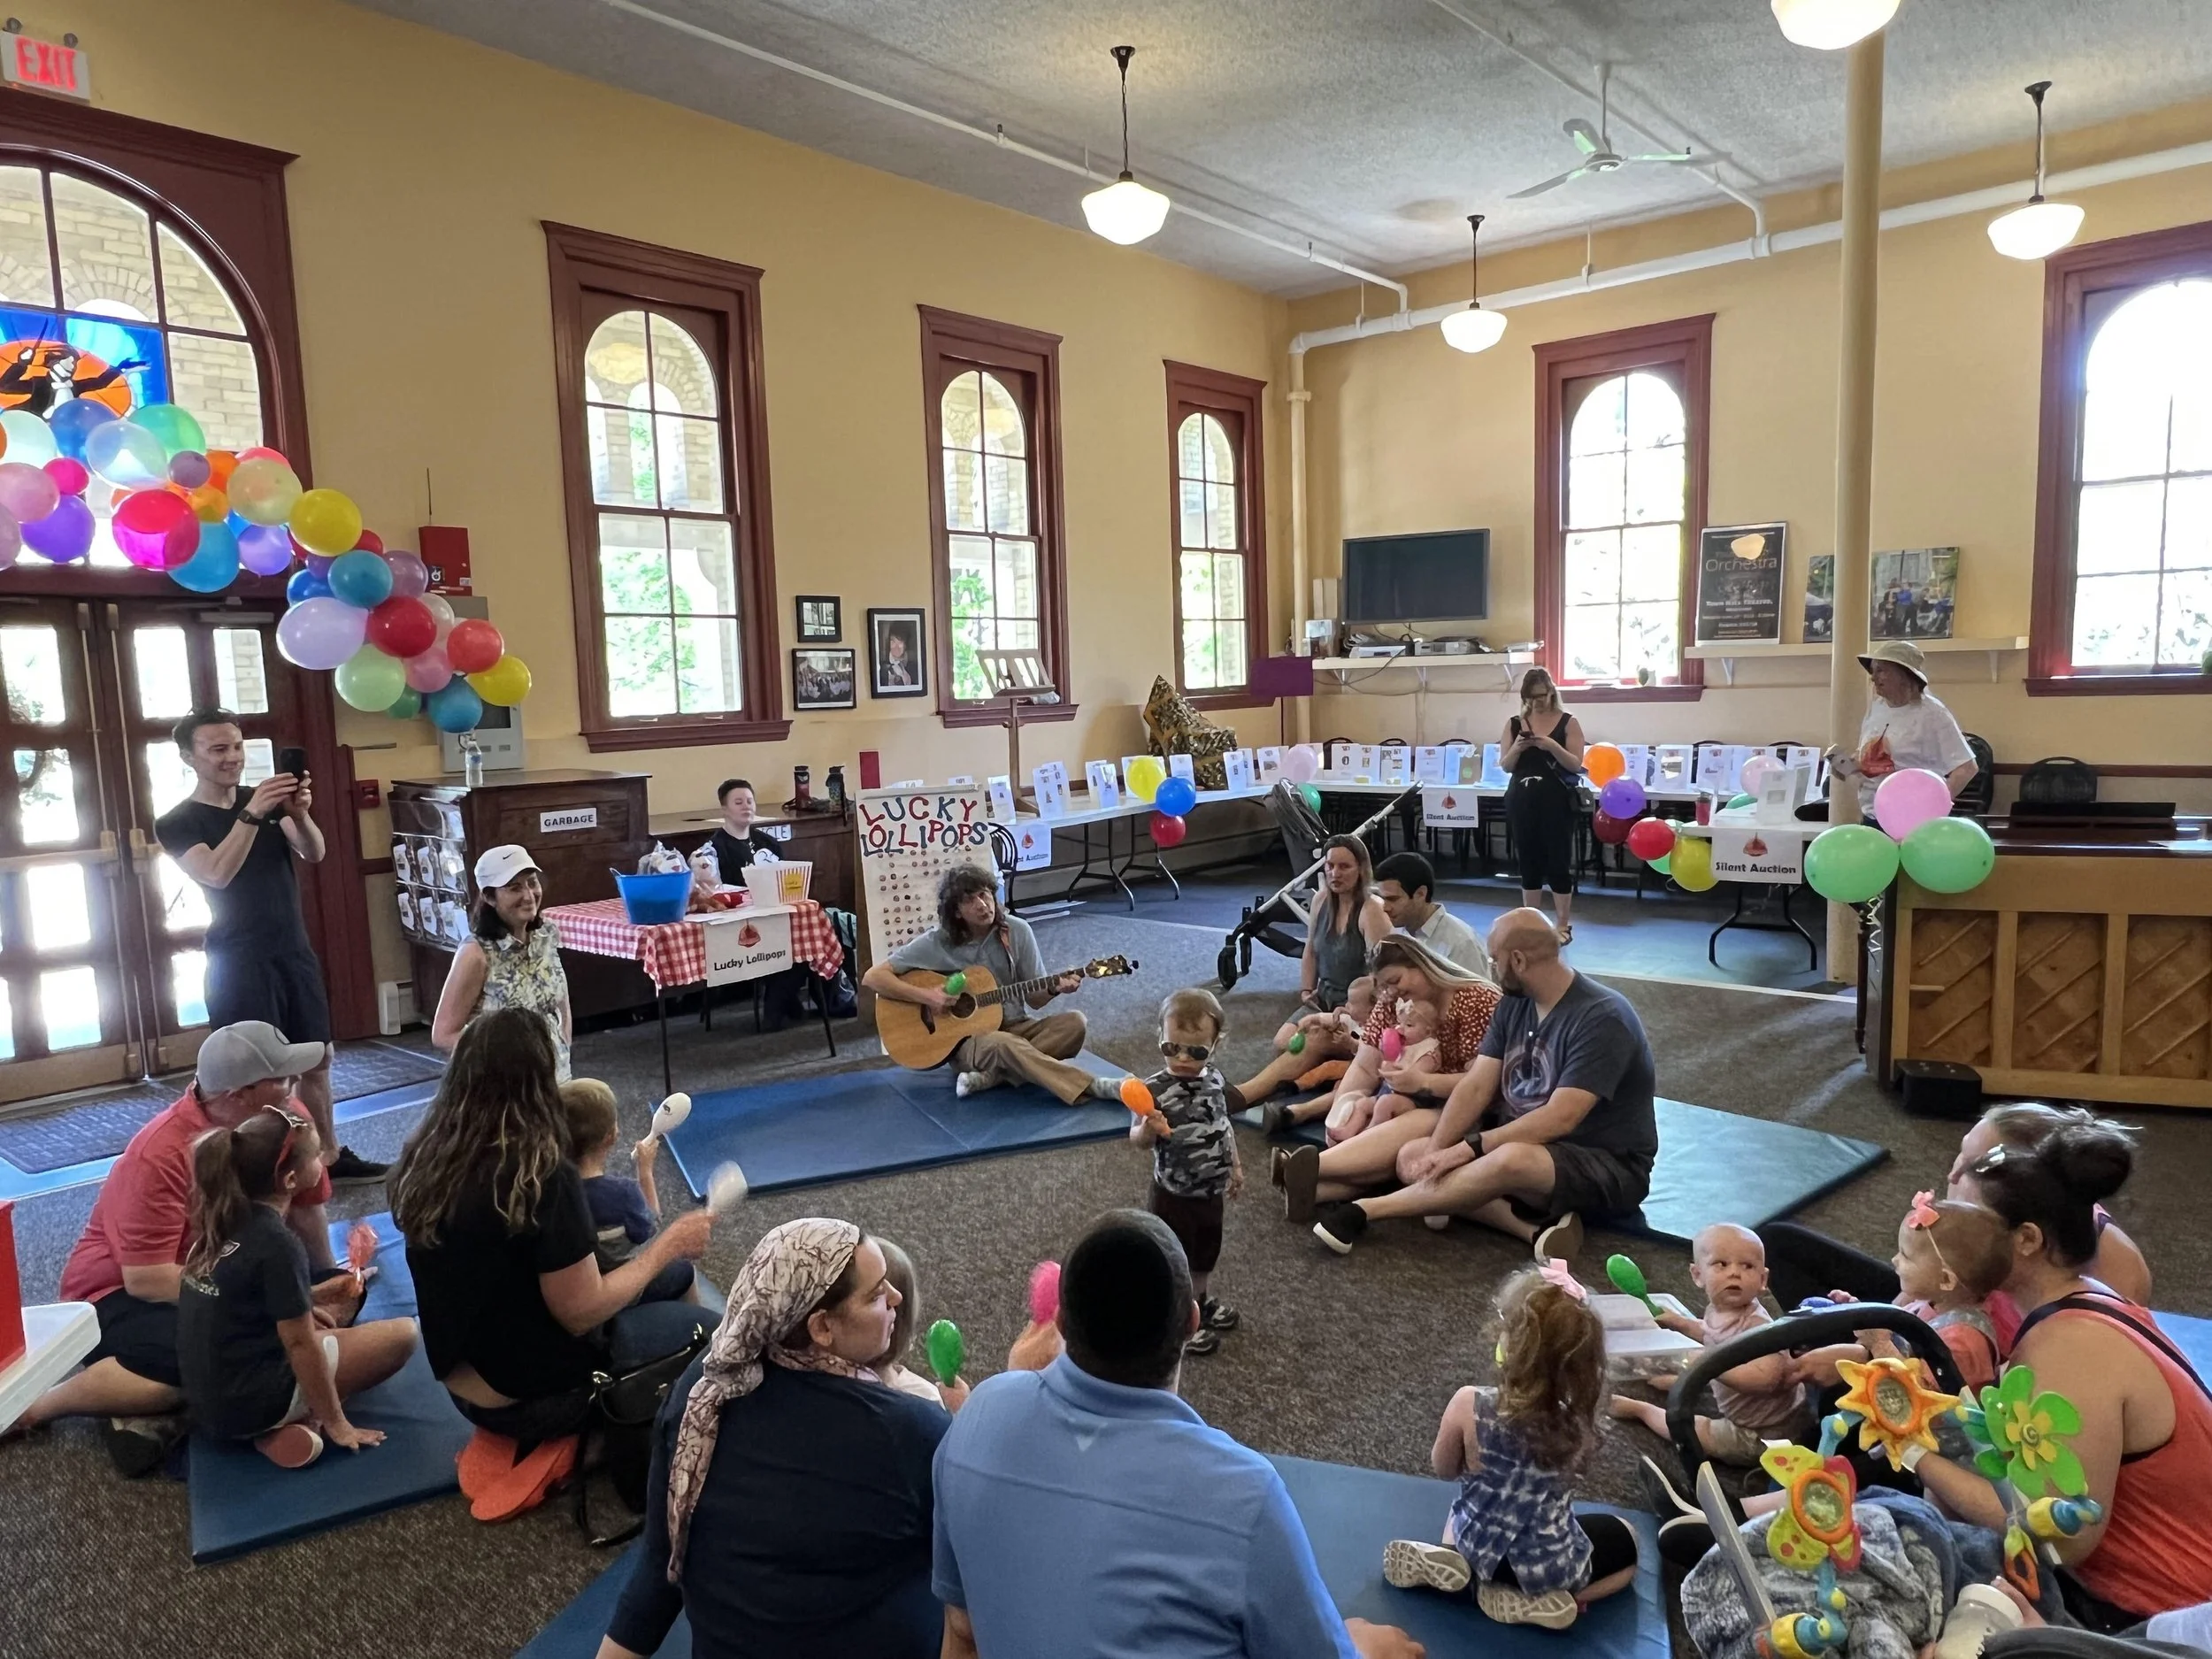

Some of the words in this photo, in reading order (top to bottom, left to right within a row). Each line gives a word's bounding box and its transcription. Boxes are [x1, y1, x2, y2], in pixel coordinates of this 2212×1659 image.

[16, 36, 78, 91] EXIT
[1705, 557, 1778, 572] Orchestra
[544, 814, 595, 827] GARBAGE
[858, 796, 978, 826] LUCKY
[860, 819, 988, 857] LOLLIPOPS
[1716, 862, 1747, 872] Silent
[1750, 864, 1796, 874] Auction
[714, 958, 743, 972] Lucky
[746, 949, 786, 964] Lollipops
